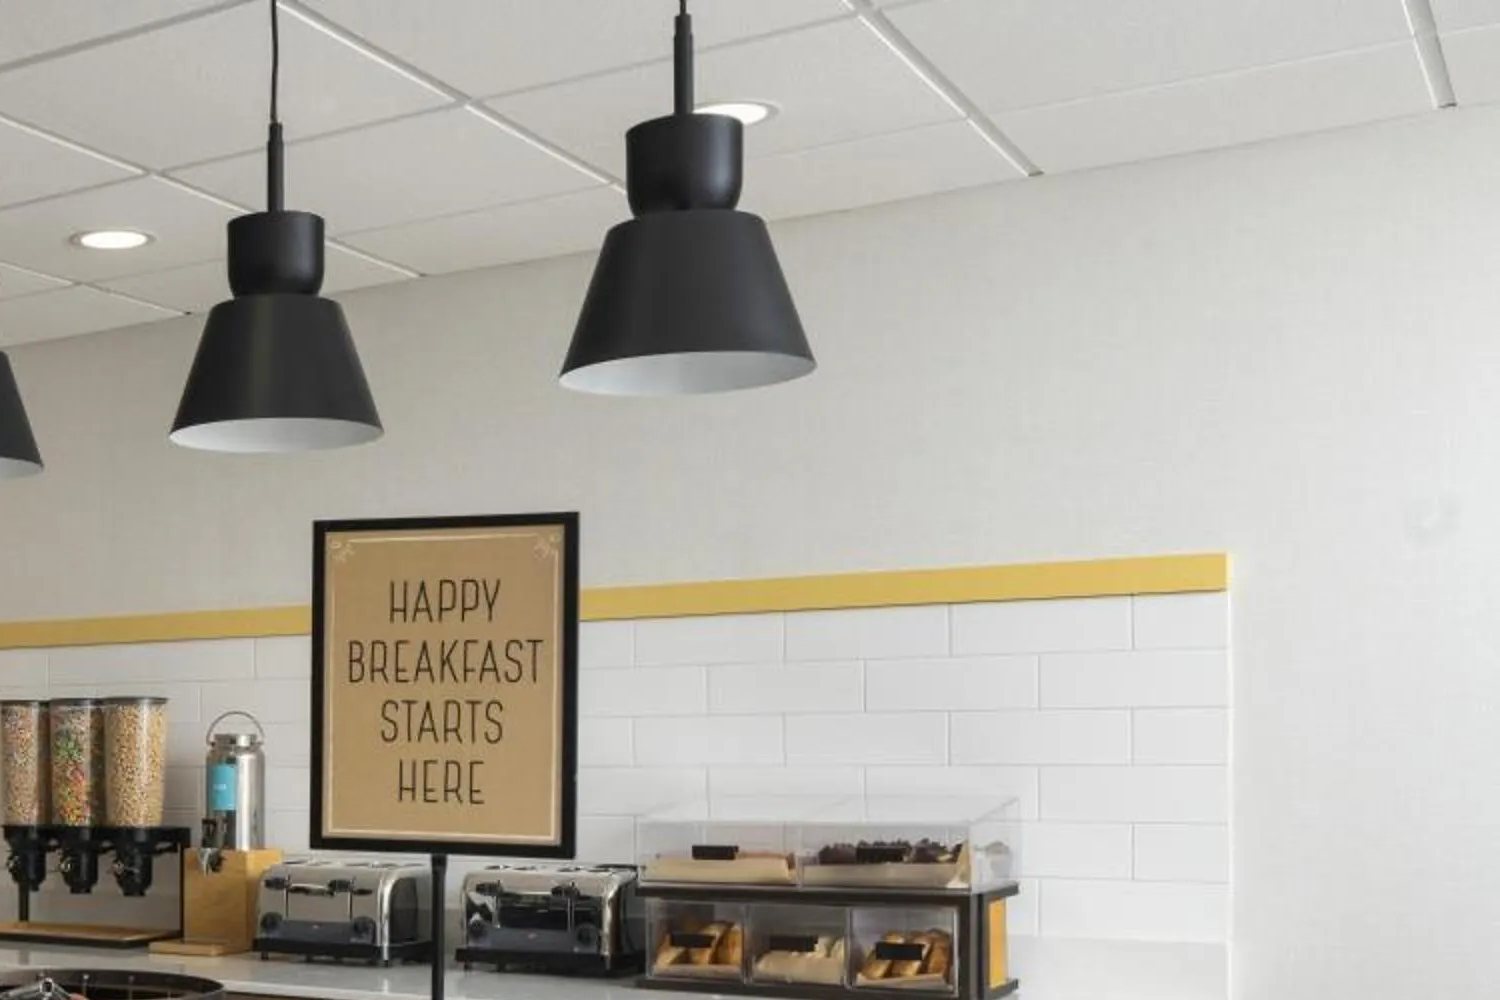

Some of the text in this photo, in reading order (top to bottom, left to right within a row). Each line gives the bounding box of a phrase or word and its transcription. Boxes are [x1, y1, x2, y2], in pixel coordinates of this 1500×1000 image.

[390, 578, 501, 624] HAPPY
[348, 639, 544, 683] BREAKFAST
[381, 699, 504, 744] STARTS
[398, 759, 485, 805] HERE
